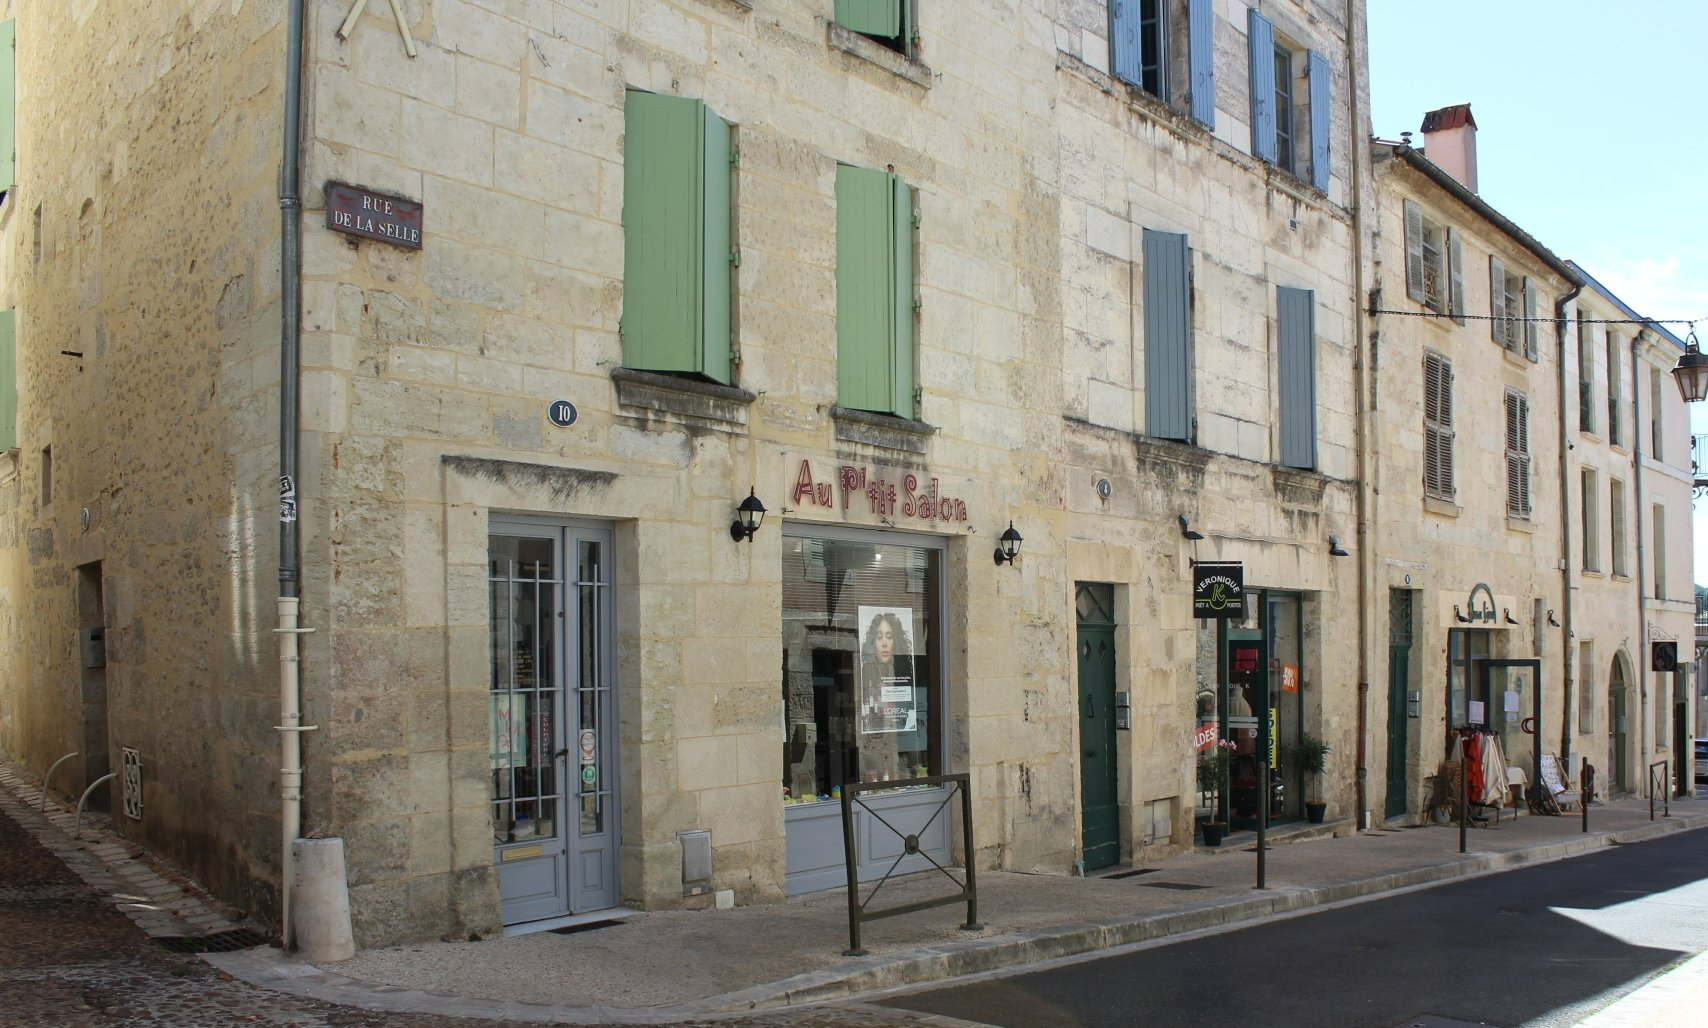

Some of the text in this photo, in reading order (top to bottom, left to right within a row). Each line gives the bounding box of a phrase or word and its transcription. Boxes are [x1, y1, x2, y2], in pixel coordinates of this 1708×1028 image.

[363, 195, 393, 215] RUE
[334, 210, 419, 243] DE LA SELLE
[558, 404, 571, 422] 10
[793, 459, 968, 522] Au P'tit Salon
[1196, 575, 1241, 594] VERONIQUE
[1211, 583, 1226, 602] K
[1193, 727, 1215, 748] LDES
